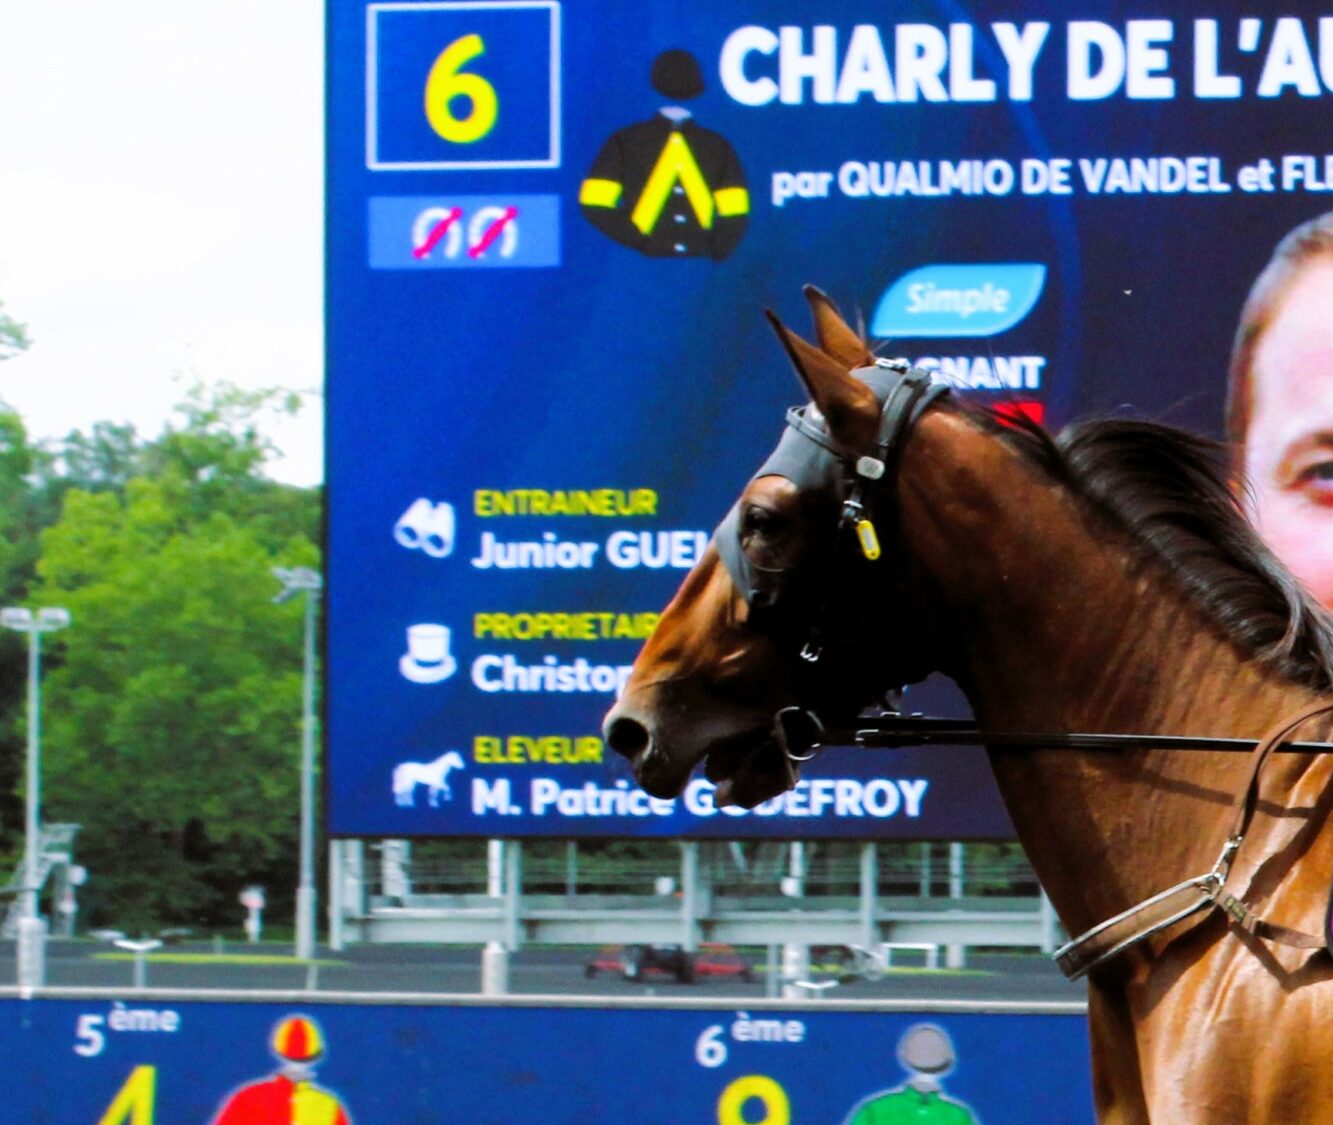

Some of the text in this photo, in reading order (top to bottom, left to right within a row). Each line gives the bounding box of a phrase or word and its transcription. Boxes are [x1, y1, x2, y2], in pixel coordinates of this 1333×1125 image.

[719, 21, 1049, 106] CHARLY
[1067, 19, 1174, 99] DE
[425, 35, 497, 143] 6
[772, 172, 832, 205] par
[838, 159, 1013, 196] QUALMIO
[1021, 158, 1072, 194] DE
[1079, 156, 1231, 193] VANDEL
[1237, 158, 1274, 191] et
[905, 281, 1010, 317] Simple
[475, 488, 656, 516] ENTRAINEUR
[471, 532, 598, 568] Junior
[474, 612, 661, 639] PROPRIETAIR
[474, 736, 602, 764] ELEVEUR
[472, 778, 521, 815] M.
